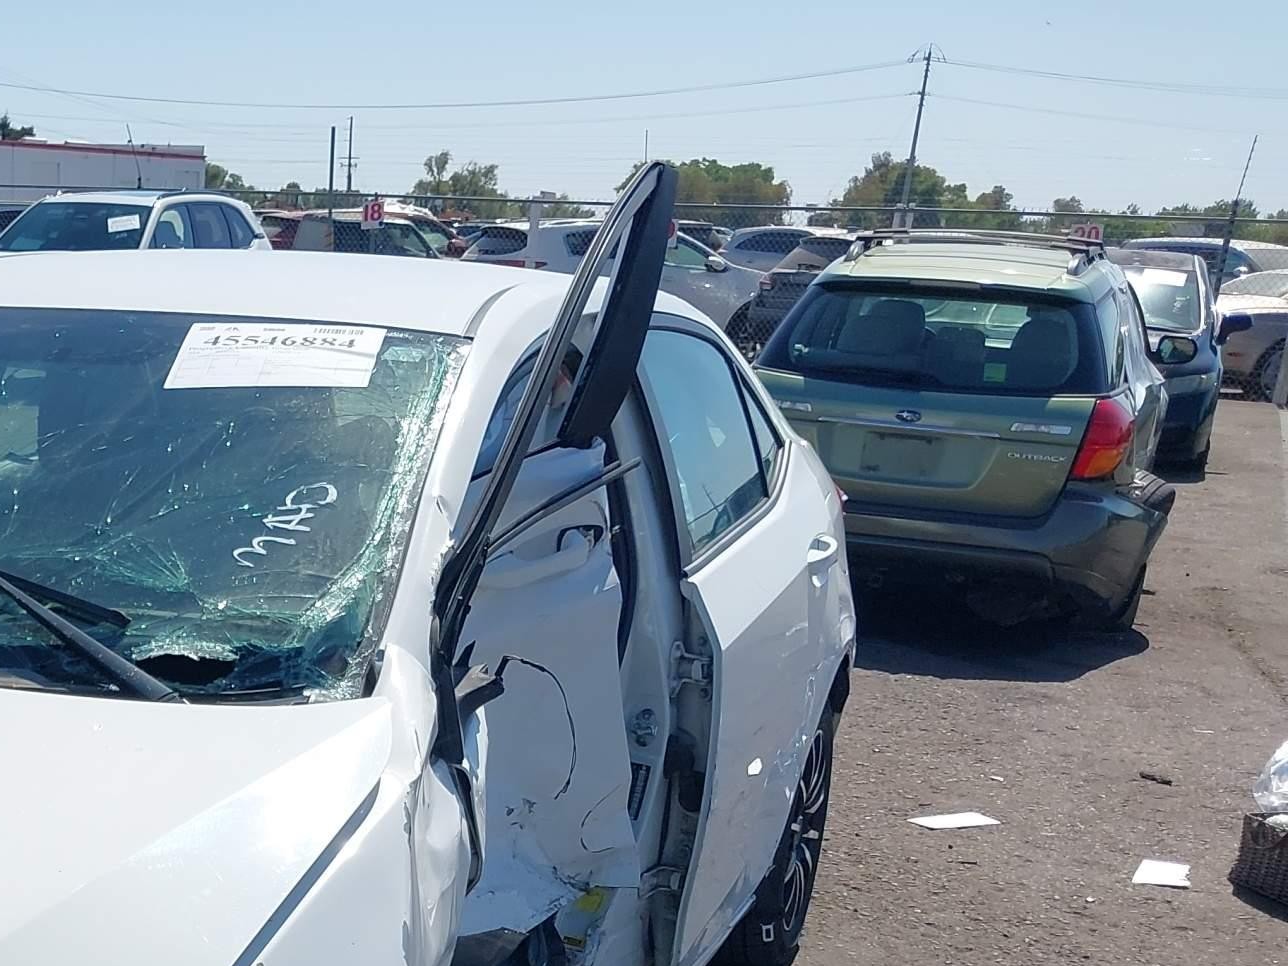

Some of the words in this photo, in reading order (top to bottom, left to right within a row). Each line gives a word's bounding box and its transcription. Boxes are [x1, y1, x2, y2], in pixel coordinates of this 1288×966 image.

[364, 203, 382, 221] 18
[203, 335, 356, 349] 45546884
[1007, 452, 1066, 463] OUTBACK
